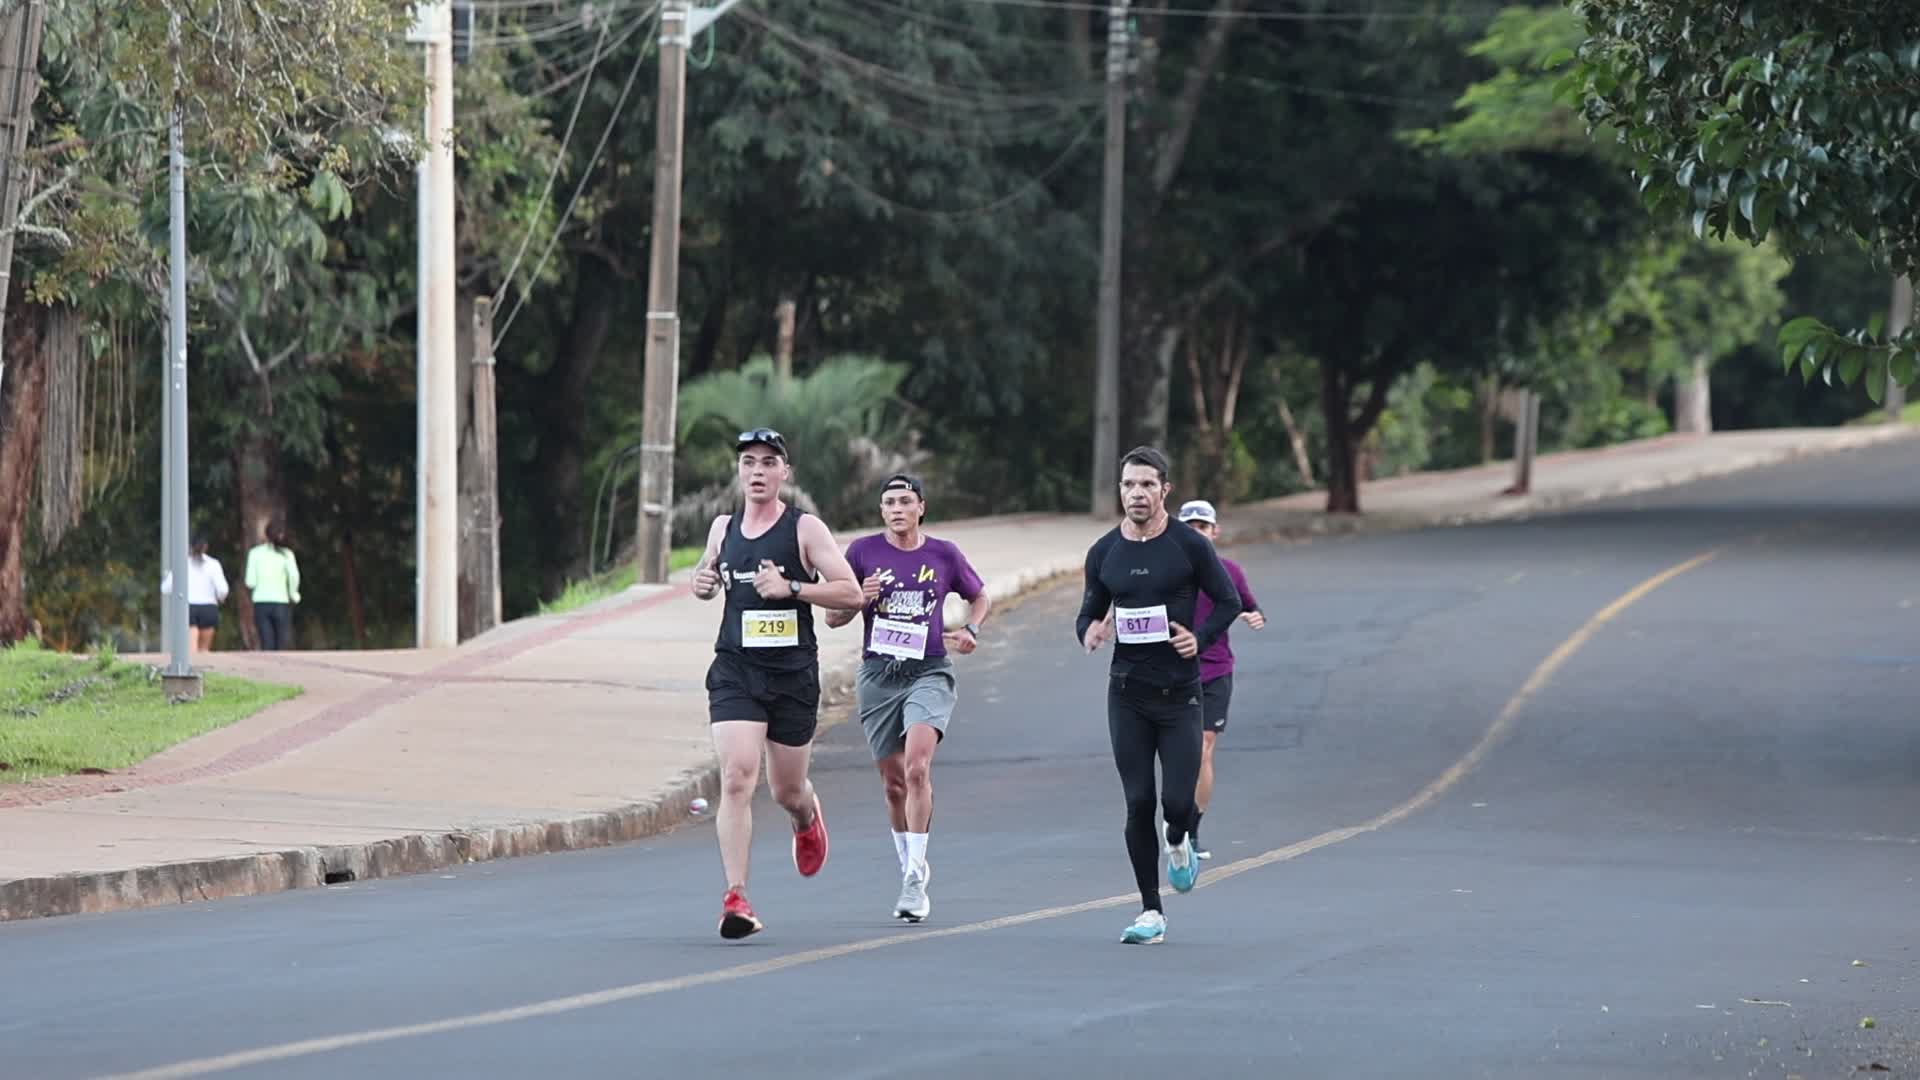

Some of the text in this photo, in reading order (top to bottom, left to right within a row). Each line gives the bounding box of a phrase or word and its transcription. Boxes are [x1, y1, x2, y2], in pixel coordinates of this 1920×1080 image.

[758, 620, 785, 633] 219
[1127, 617, 1151, 631] 617
[887, 629, 912, 644] 772
